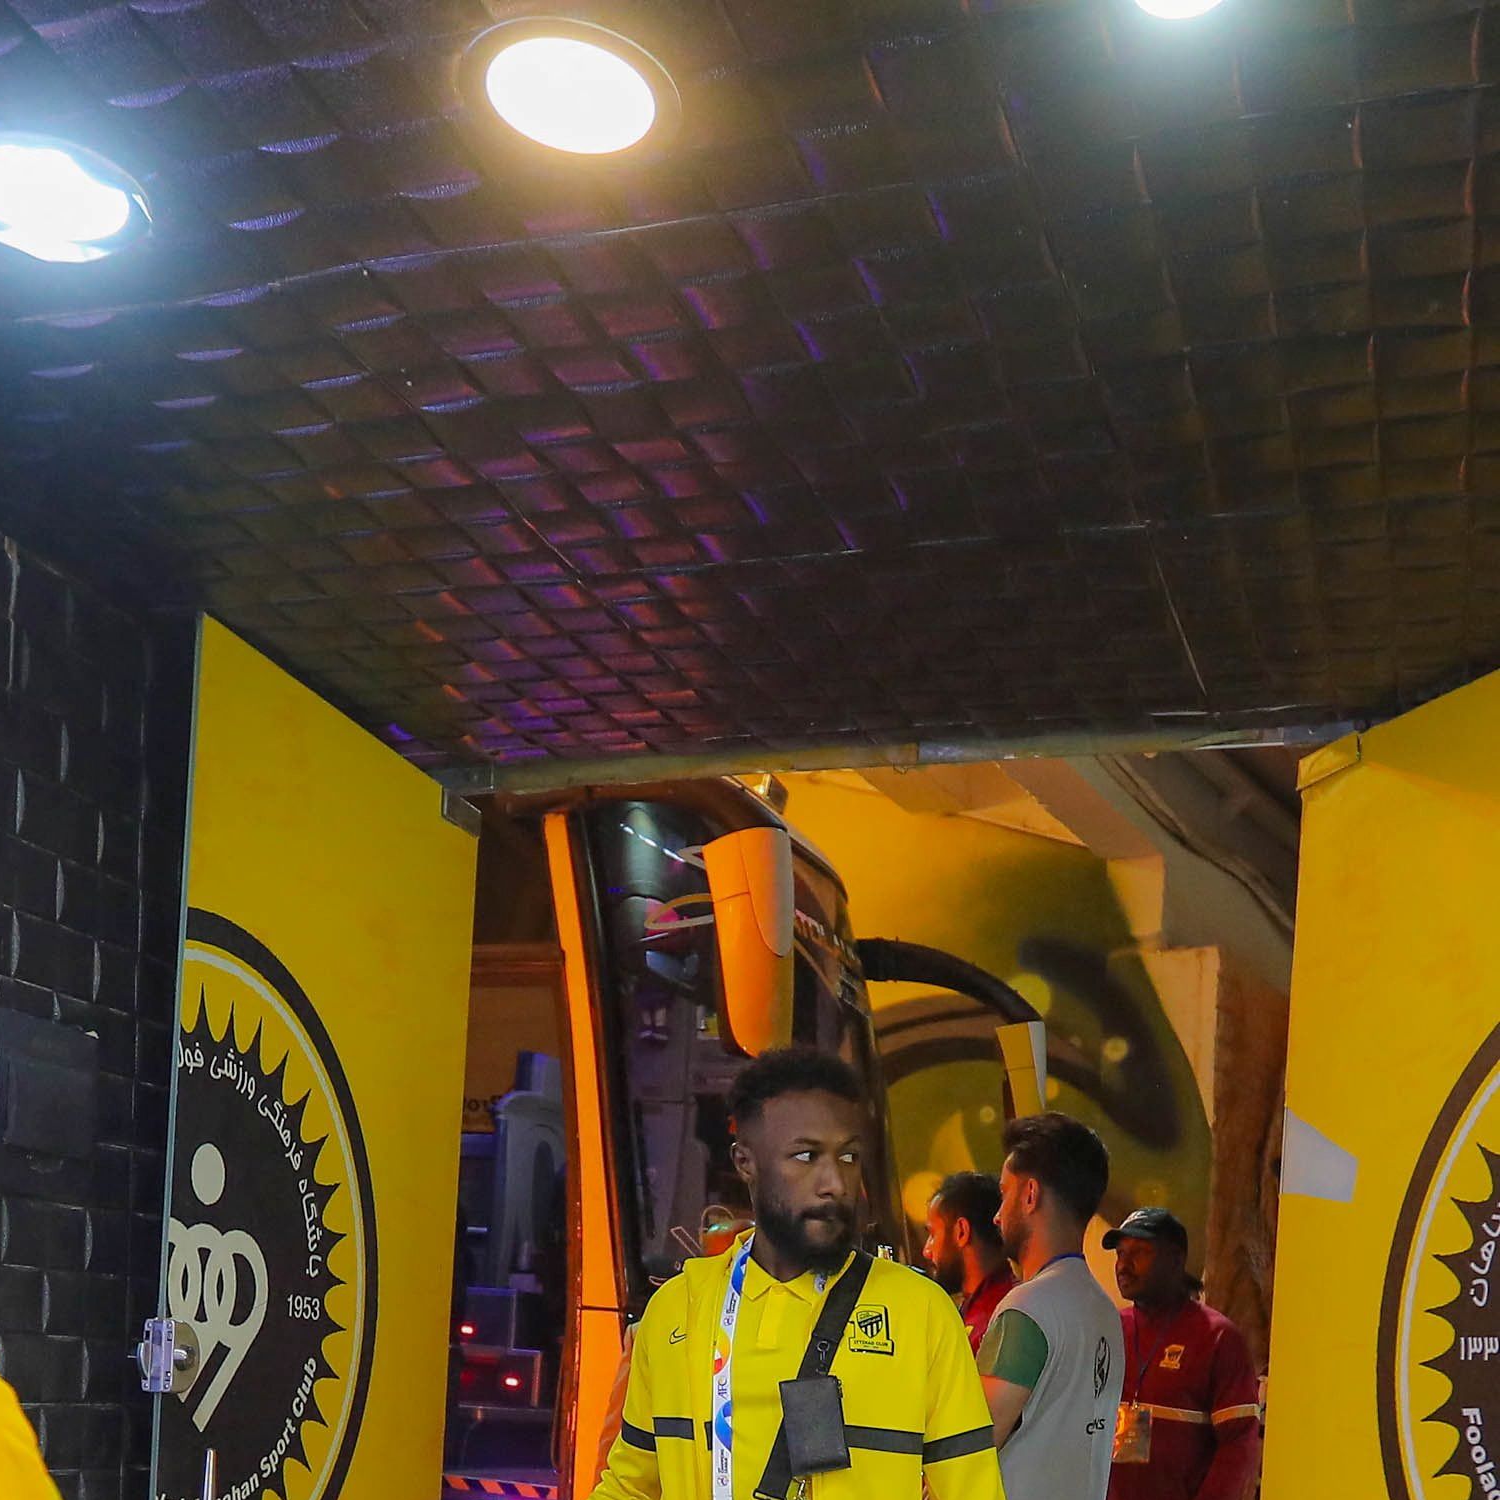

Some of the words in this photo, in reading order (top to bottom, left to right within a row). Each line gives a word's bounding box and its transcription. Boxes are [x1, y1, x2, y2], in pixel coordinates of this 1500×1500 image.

[210, 1048, 255, 1100] ورزشی
[287, 1294, 320, 1321] 1953
[717, 1376, 728, 1401] AFC
[259, 1417, 296, 1479] Sport
[292, 1357, 317, 1418] Club
